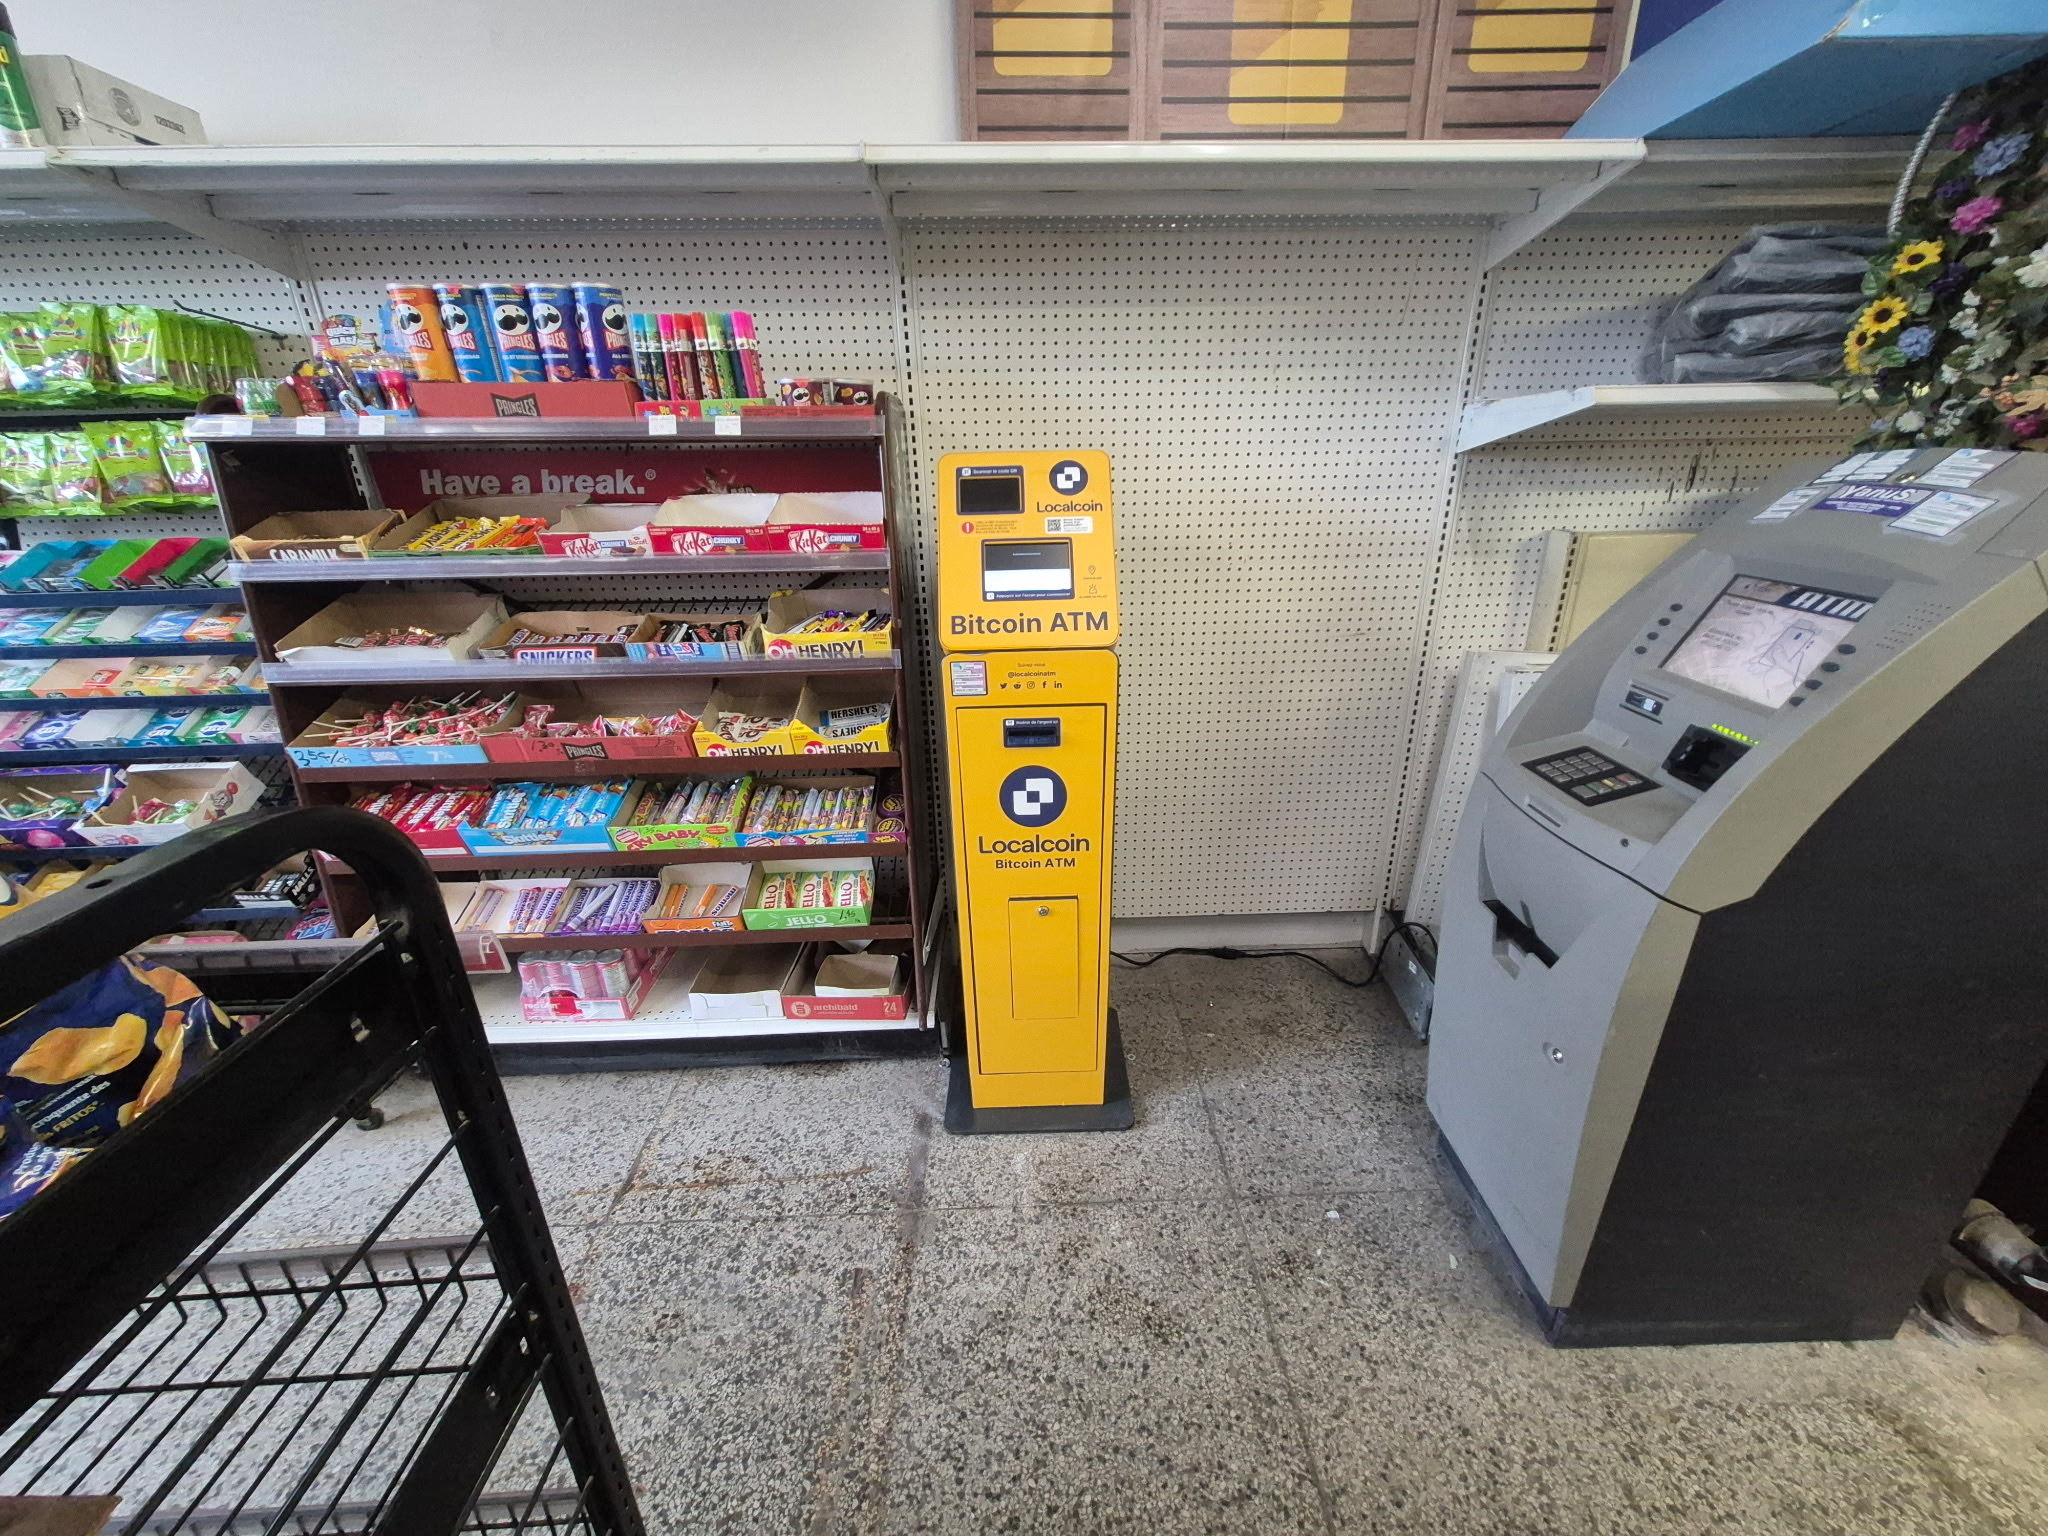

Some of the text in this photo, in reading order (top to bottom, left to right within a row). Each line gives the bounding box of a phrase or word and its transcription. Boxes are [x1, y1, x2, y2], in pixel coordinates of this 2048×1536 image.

[495, 398, 537, 417] PRINGLES
[420, 469, 500, 495] Have
[511, 475, 531, 495] a
[1036, 500, 1103, 513] Localcoin
[677, 532, 711, 555] KitKat
[713, 536, 742, 545] CHUNKY
[794, 529, 828, 553] KitKat
[829, 534, 858, 543] CHUNKY
[269, 548, 341, 562] CARAMILK
[951, 611, 1109, 635] Bitcoin ATM
[520, 650, 593, 664] SNICKERS
[767, 639, 864, 659] OH HENRY!
[831, 704, 878, 719] HERSHEY'S
[565, 745, 606, 759] PRINGLES
[706, 744, 784, 758] OH HENRY!
[803, 741, 880, 755] OH HENRY!
[502, 831, 557, 845] Skittles
[626, 835, 654, 851] CRY
[654, 829, 701, 842] BABY
[978, 833, 1090, 854] Localcoin
[995, 858, 1076, 868] Bitcoin ATM
[291, 866, 317, 896] HALLS
[618, 882, 636, 912] mentos
[711, 887, 738, 916] mentos
[764, 884, 779, 909] ELL-O
[802, 883, 816, 908] ELL-O
[841, 882, 853, 907] ELL-O
[786, 914, 827, 927] JELL-O
[813, 1003, 858, 1011] archibald
[884, 1001, 897, 1013] 24
[31, 1080, 111, 1130] croquante des
